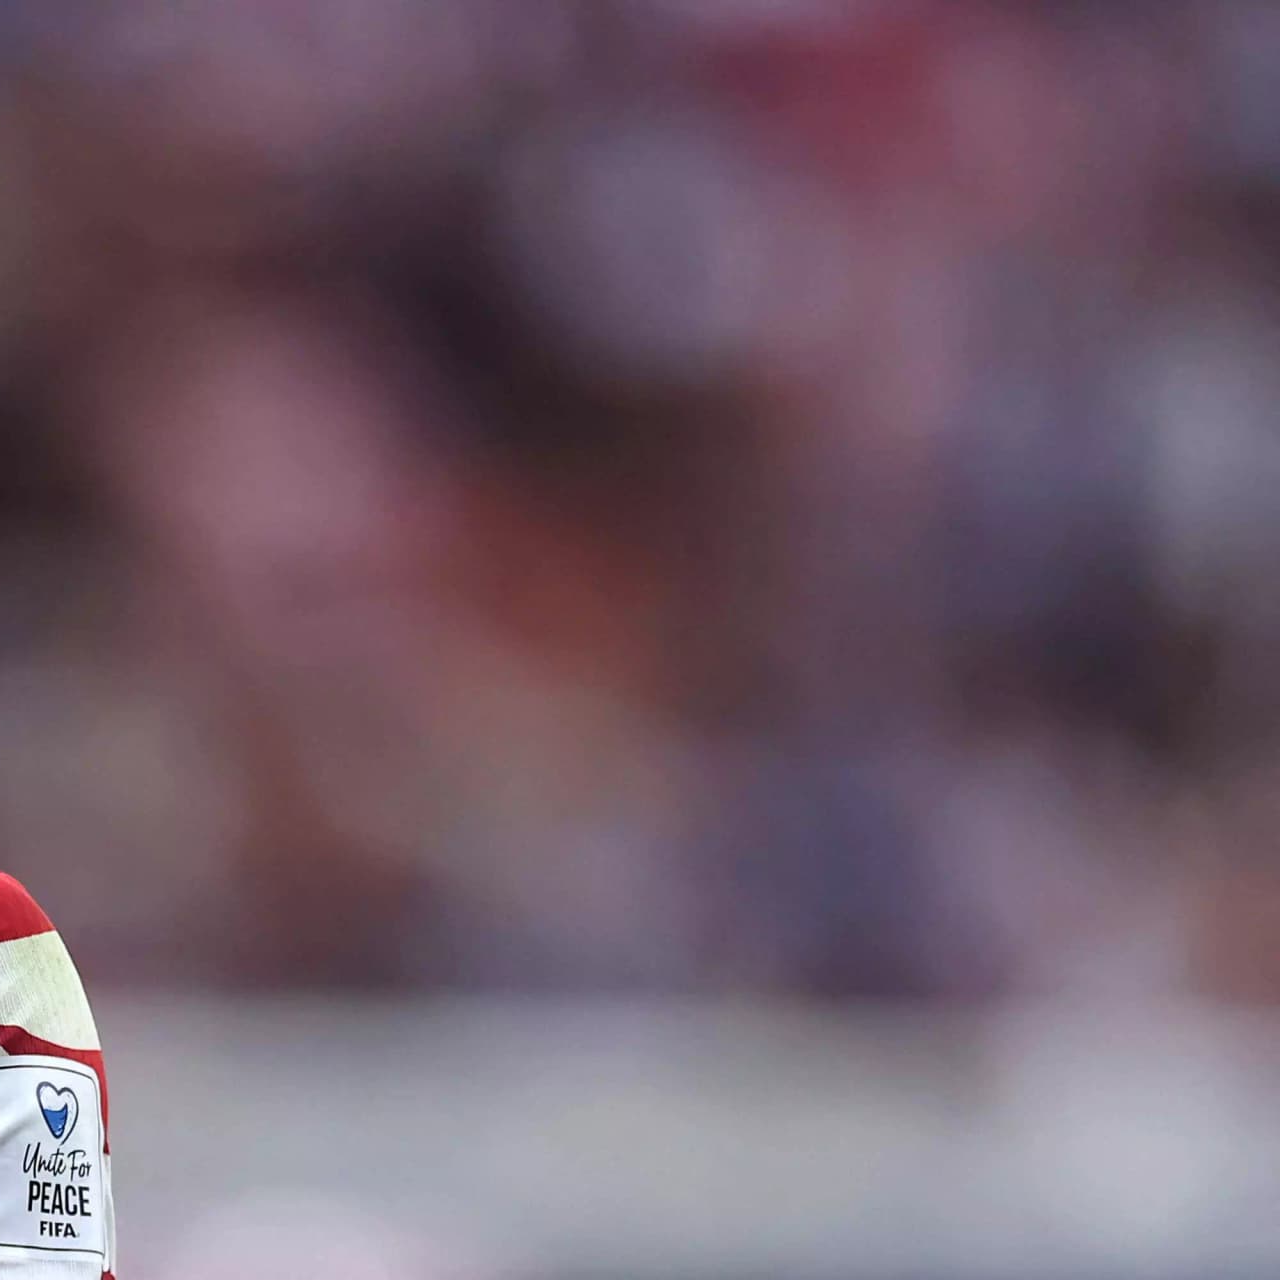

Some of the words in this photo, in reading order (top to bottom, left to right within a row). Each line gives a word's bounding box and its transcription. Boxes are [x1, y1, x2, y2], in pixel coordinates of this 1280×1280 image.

[23, 1142, 66, 1179] Unite
[67, 1150, 92, 1182] For
[28, 1181, 92, 1217] PEACE
[40, 1221, 77, 1239] FIFA
